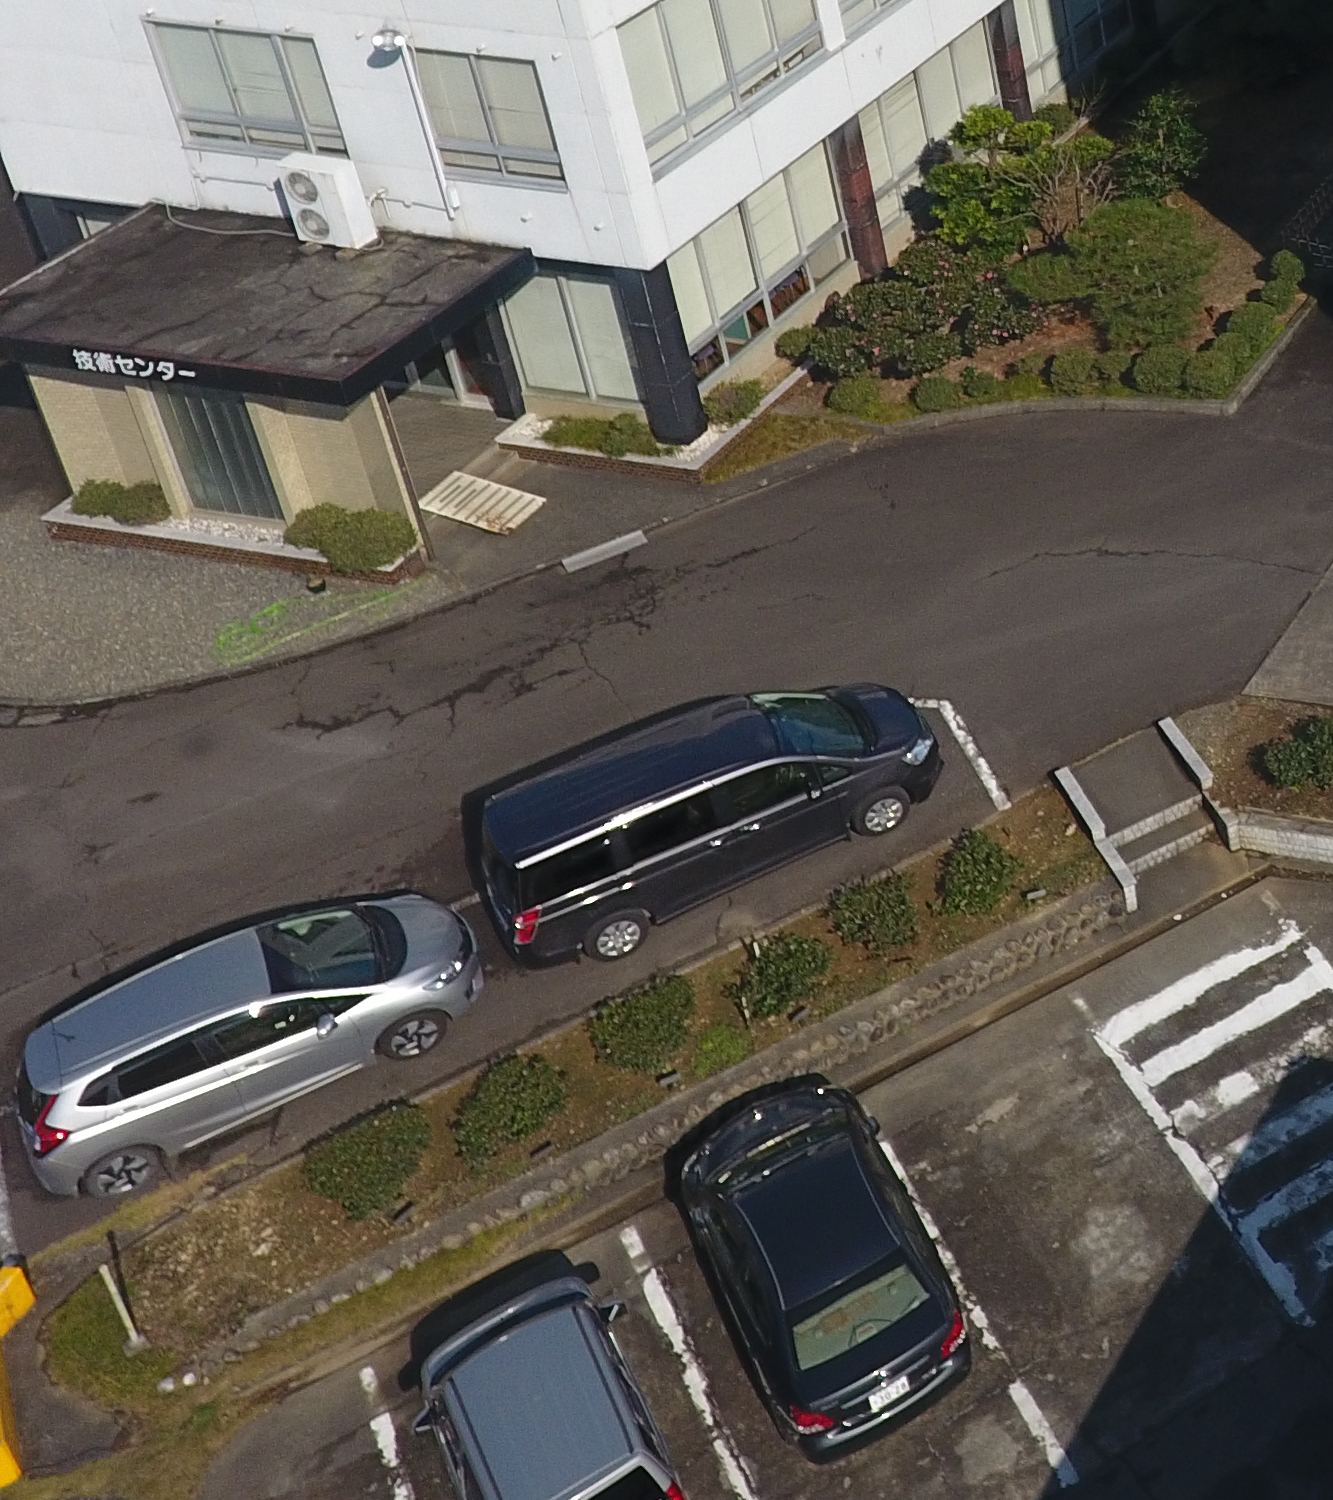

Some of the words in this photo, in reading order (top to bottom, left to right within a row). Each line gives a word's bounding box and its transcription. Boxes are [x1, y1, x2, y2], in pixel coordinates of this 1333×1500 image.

[72, 348, 196, 381] 技術センター
